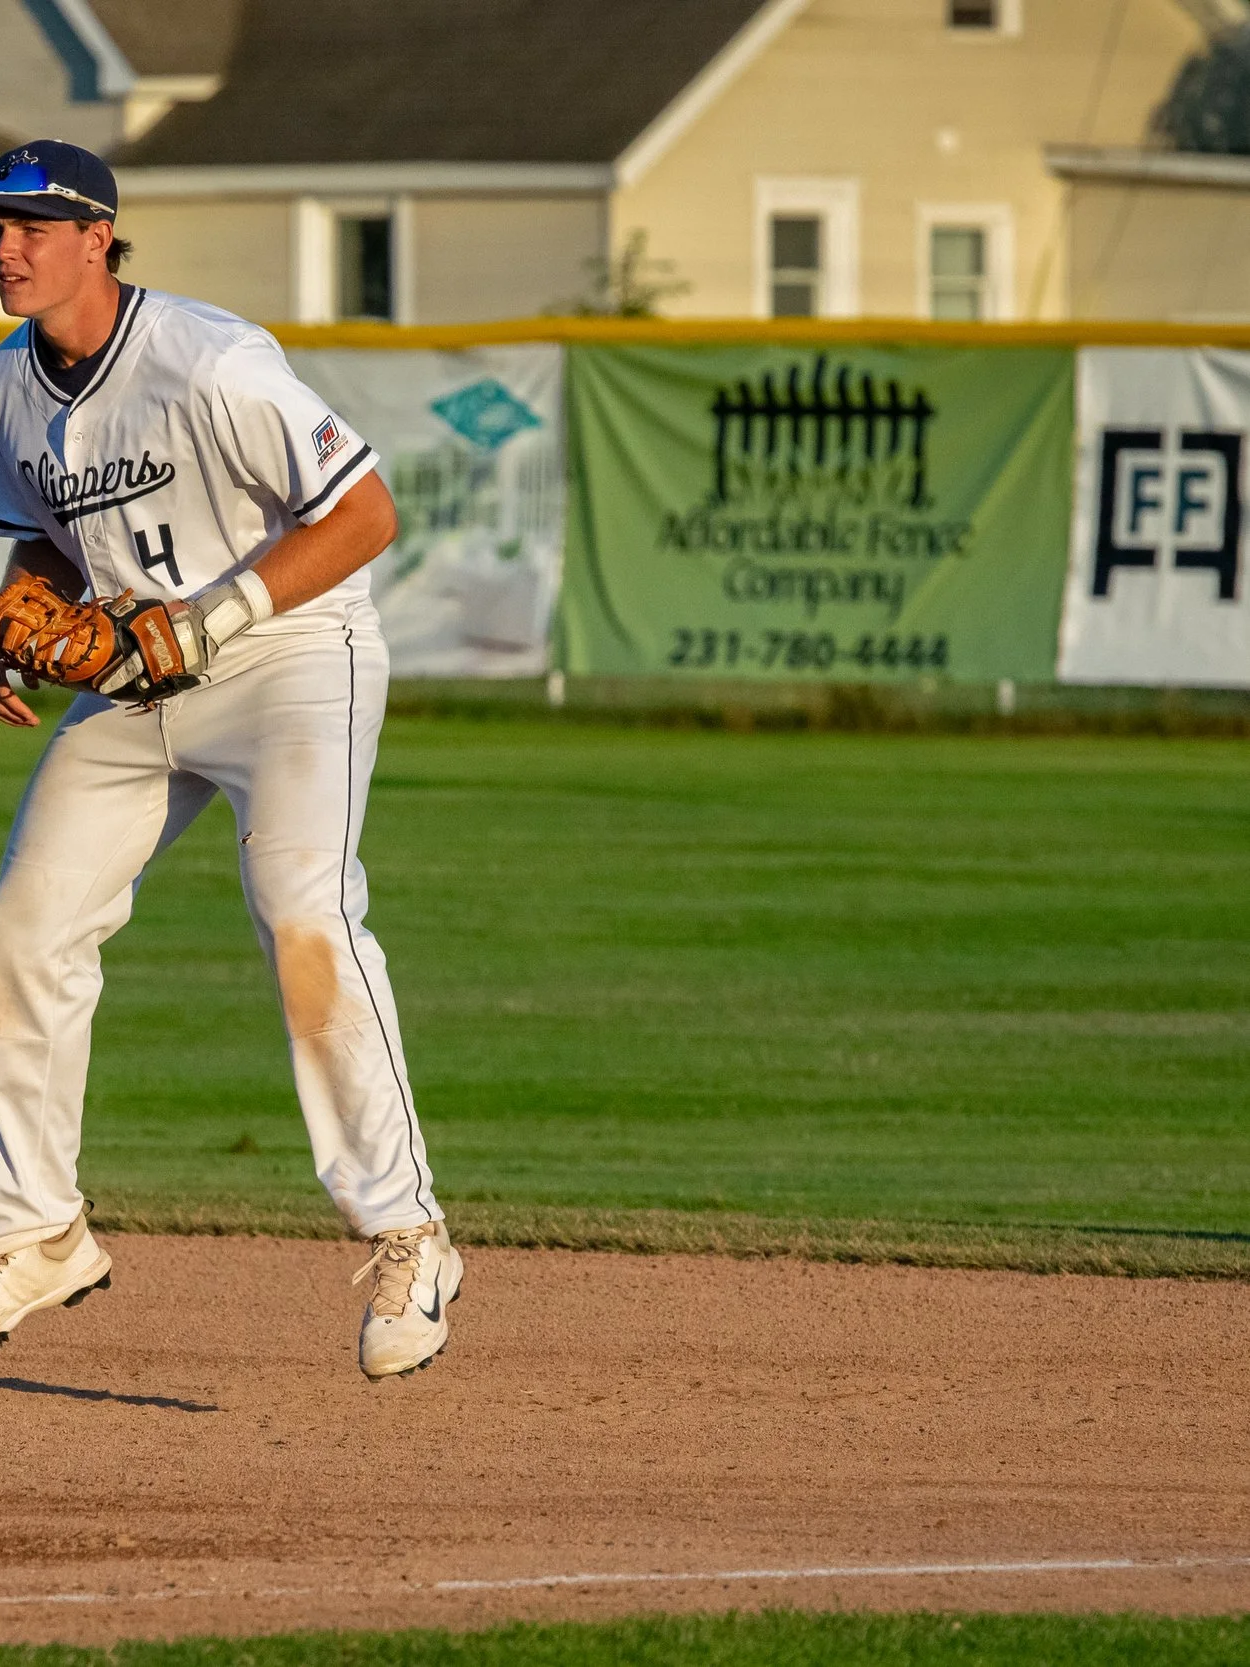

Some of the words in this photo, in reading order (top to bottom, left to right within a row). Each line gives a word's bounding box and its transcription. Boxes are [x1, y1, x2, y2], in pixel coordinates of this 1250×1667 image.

[19, 450, 176, 512] Clippers
[133, 523, 185, 588] 4
[655, 502, 859, 556] Affordable
[865, 509, 972, 559] Fence
[722, 556, 905, 625] Company
[668, 626, 949, 671] 231-780-4444
